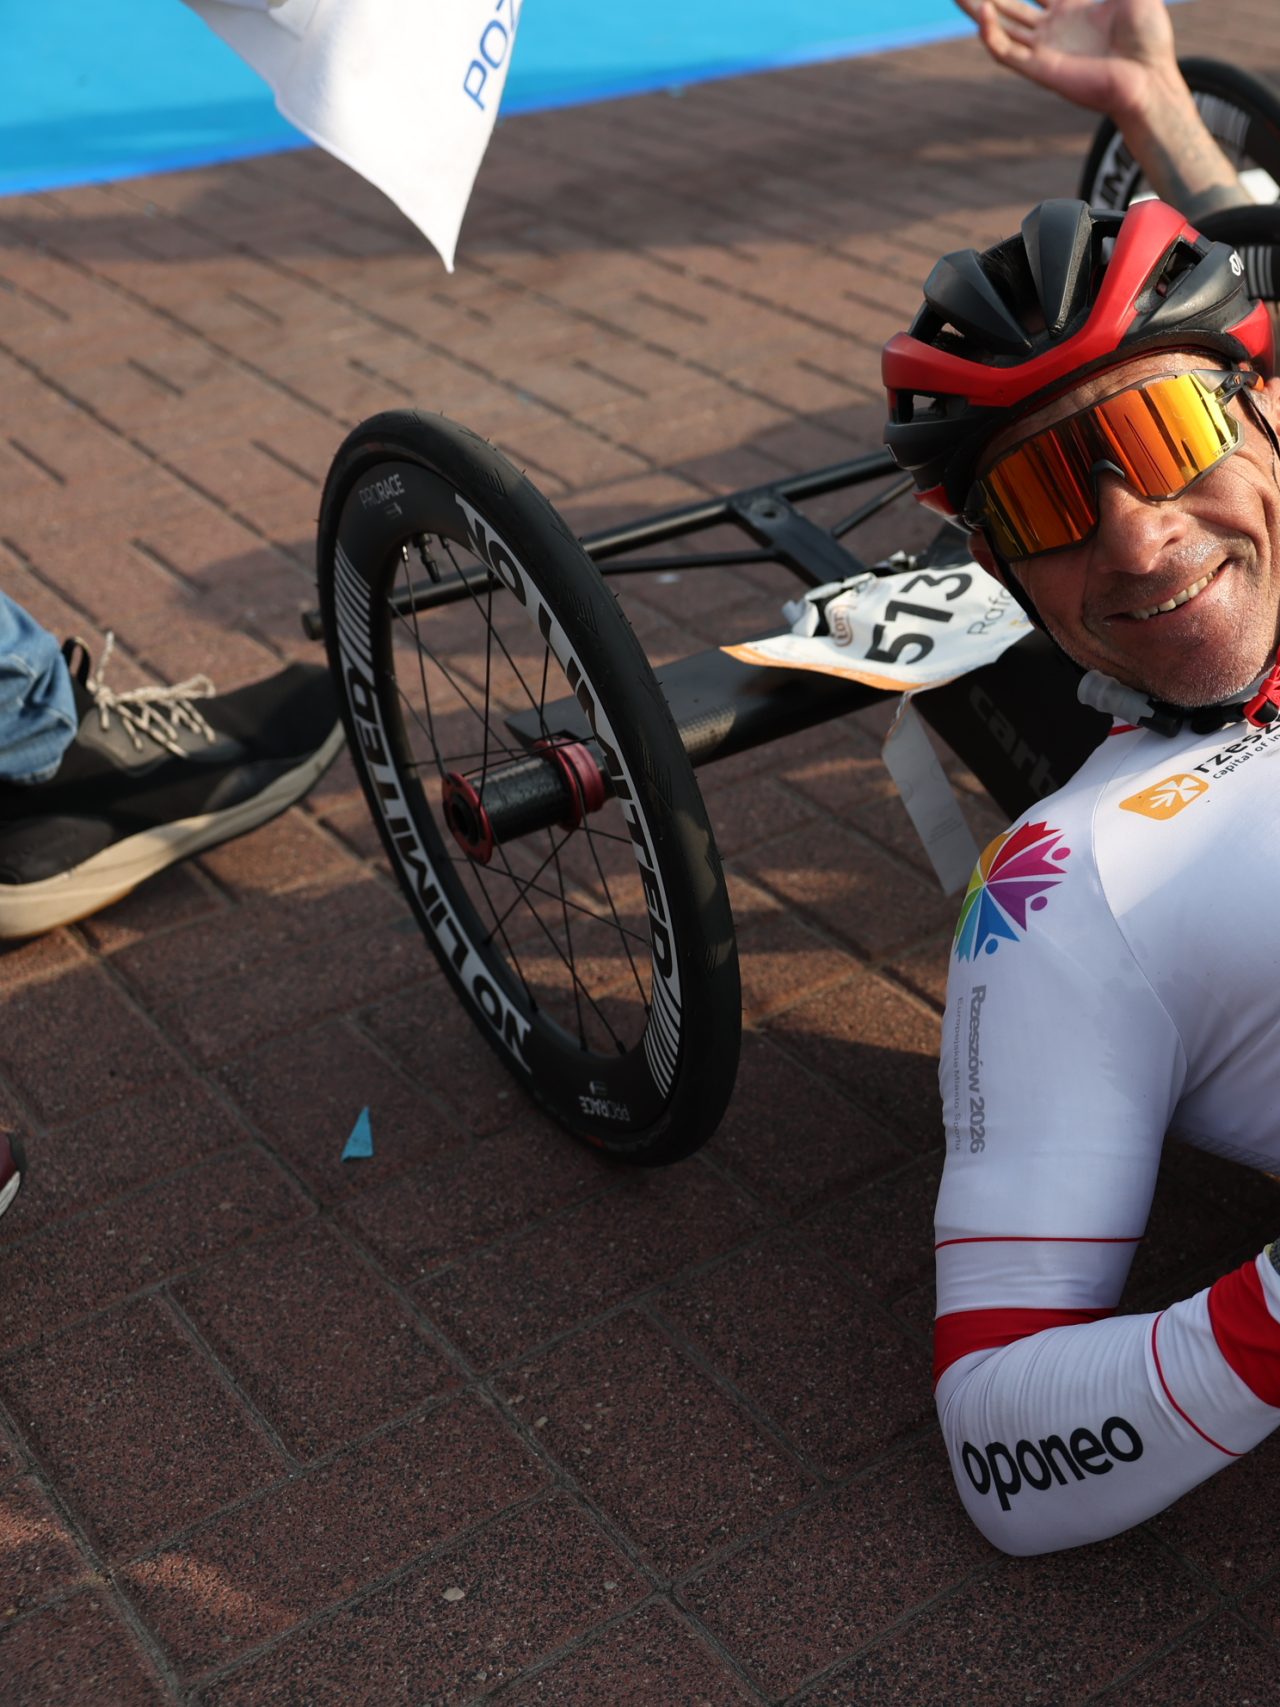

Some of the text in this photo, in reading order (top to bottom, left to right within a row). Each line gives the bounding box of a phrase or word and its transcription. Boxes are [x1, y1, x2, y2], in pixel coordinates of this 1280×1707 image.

[463, 0, 514, 111] PO
[358, 473, 405, 510] PRORACE
[864, 572, 973, 665] 513
[1212, 752, 1254, 780] capital
[1254, 741, 1268, 753] of
[968, 984, 987, 1154] Rzeszów 2026
[961, 1416, 1144, 1511] oponeo
